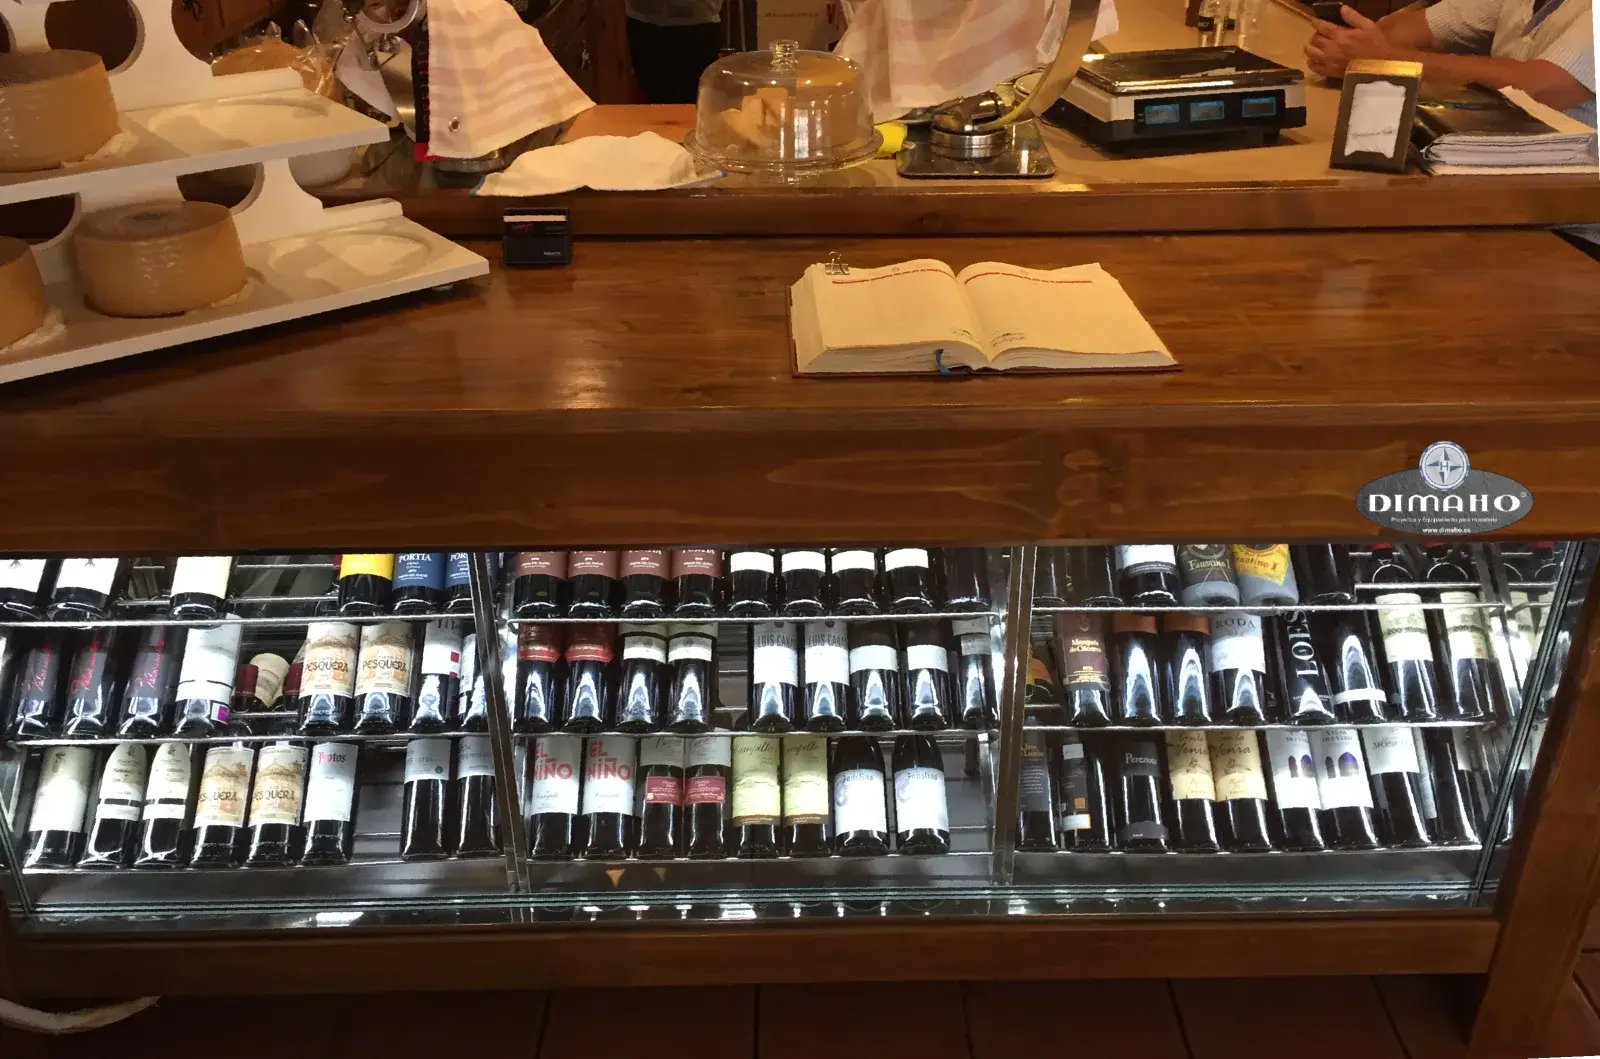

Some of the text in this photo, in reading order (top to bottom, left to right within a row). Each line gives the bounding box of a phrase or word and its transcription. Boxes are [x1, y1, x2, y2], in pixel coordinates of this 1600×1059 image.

[398, 553, 432, 563] PORTIA
[450, 552, 468, 562] POR
[1215, 618, 1257, 629] RODA
[362, 659, 407, 673] PESQUERA
[317, 751, 346, 765] Protos
